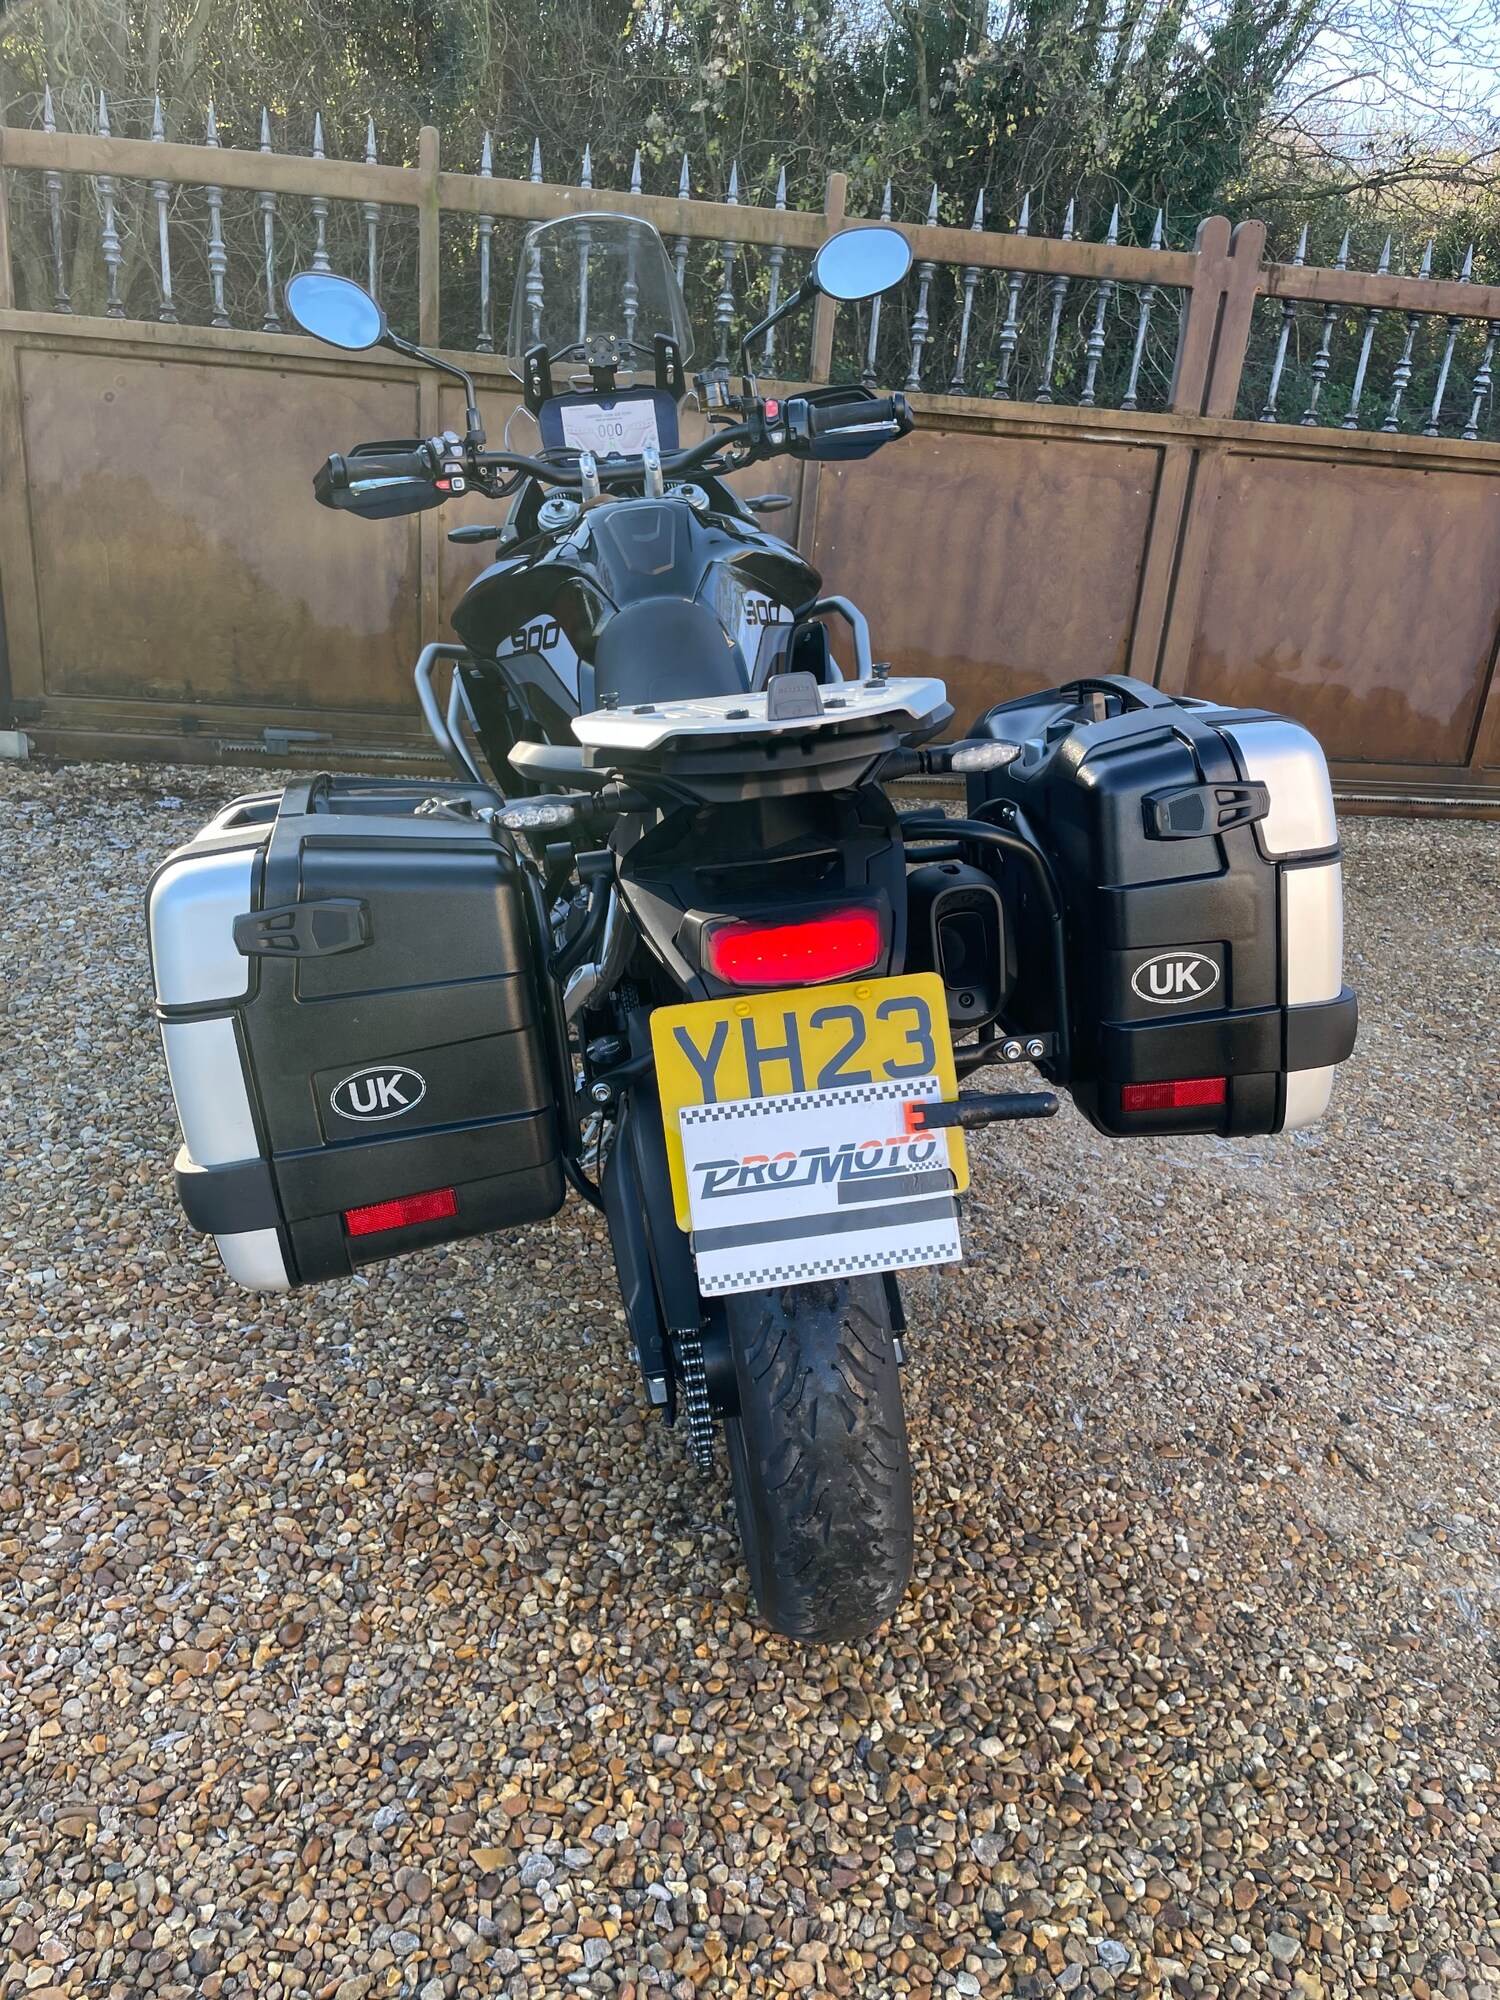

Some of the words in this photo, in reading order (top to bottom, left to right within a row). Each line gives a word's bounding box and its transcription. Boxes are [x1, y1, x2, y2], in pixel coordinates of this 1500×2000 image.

[598, 423, 623, 438] 000
[511, 621, 561, 653] 900
[1149, 960, 1202, 995] UK
[672, 996, 937, 1105] YH23
[347, 1073, 410, 1113] UK
